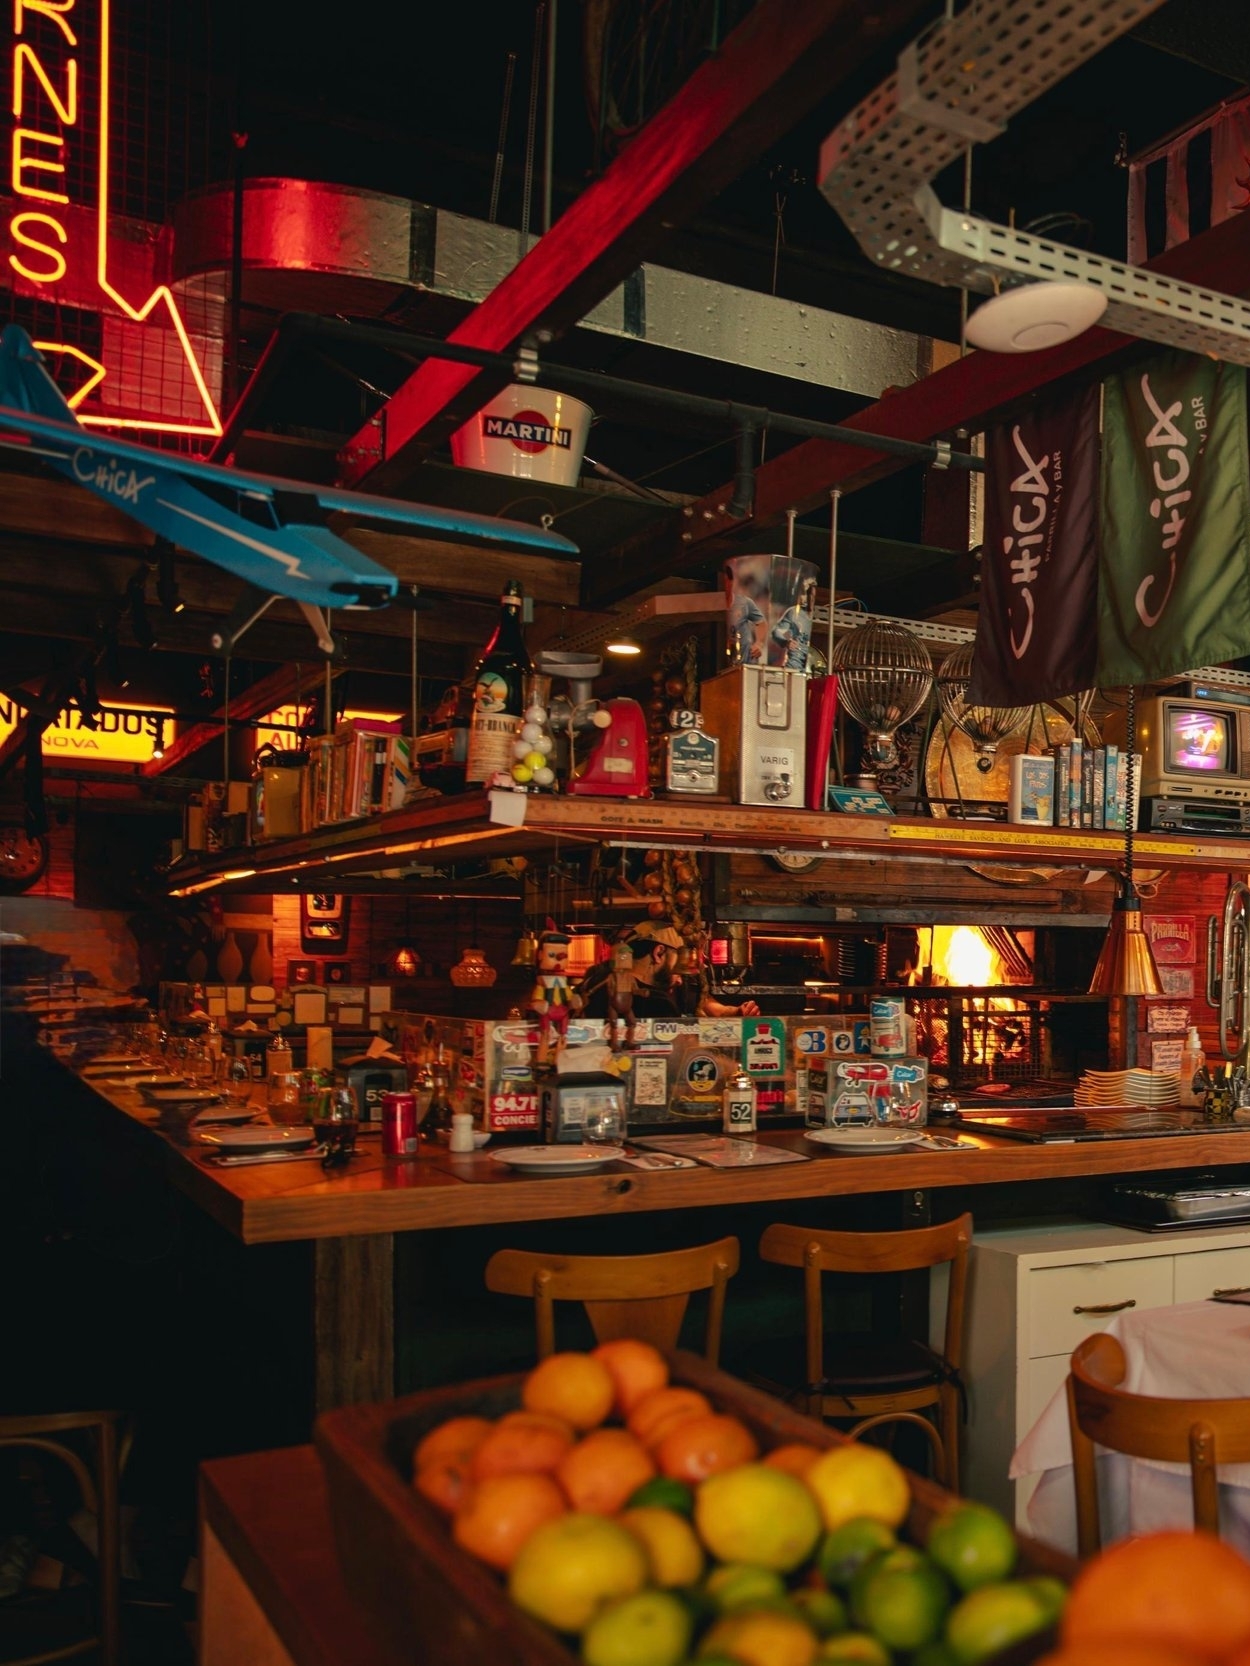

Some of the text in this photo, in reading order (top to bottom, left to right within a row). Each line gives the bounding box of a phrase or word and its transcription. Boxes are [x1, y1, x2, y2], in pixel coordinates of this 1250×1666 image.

[1191, 396, 1208, 429] BAR
[486, 416, 571, 450] MARTINI
[1052, 450, 1063, 481] BAR
[761, 754, 788, 766] VARIG
[730, 1102, 751, 1120] 52
